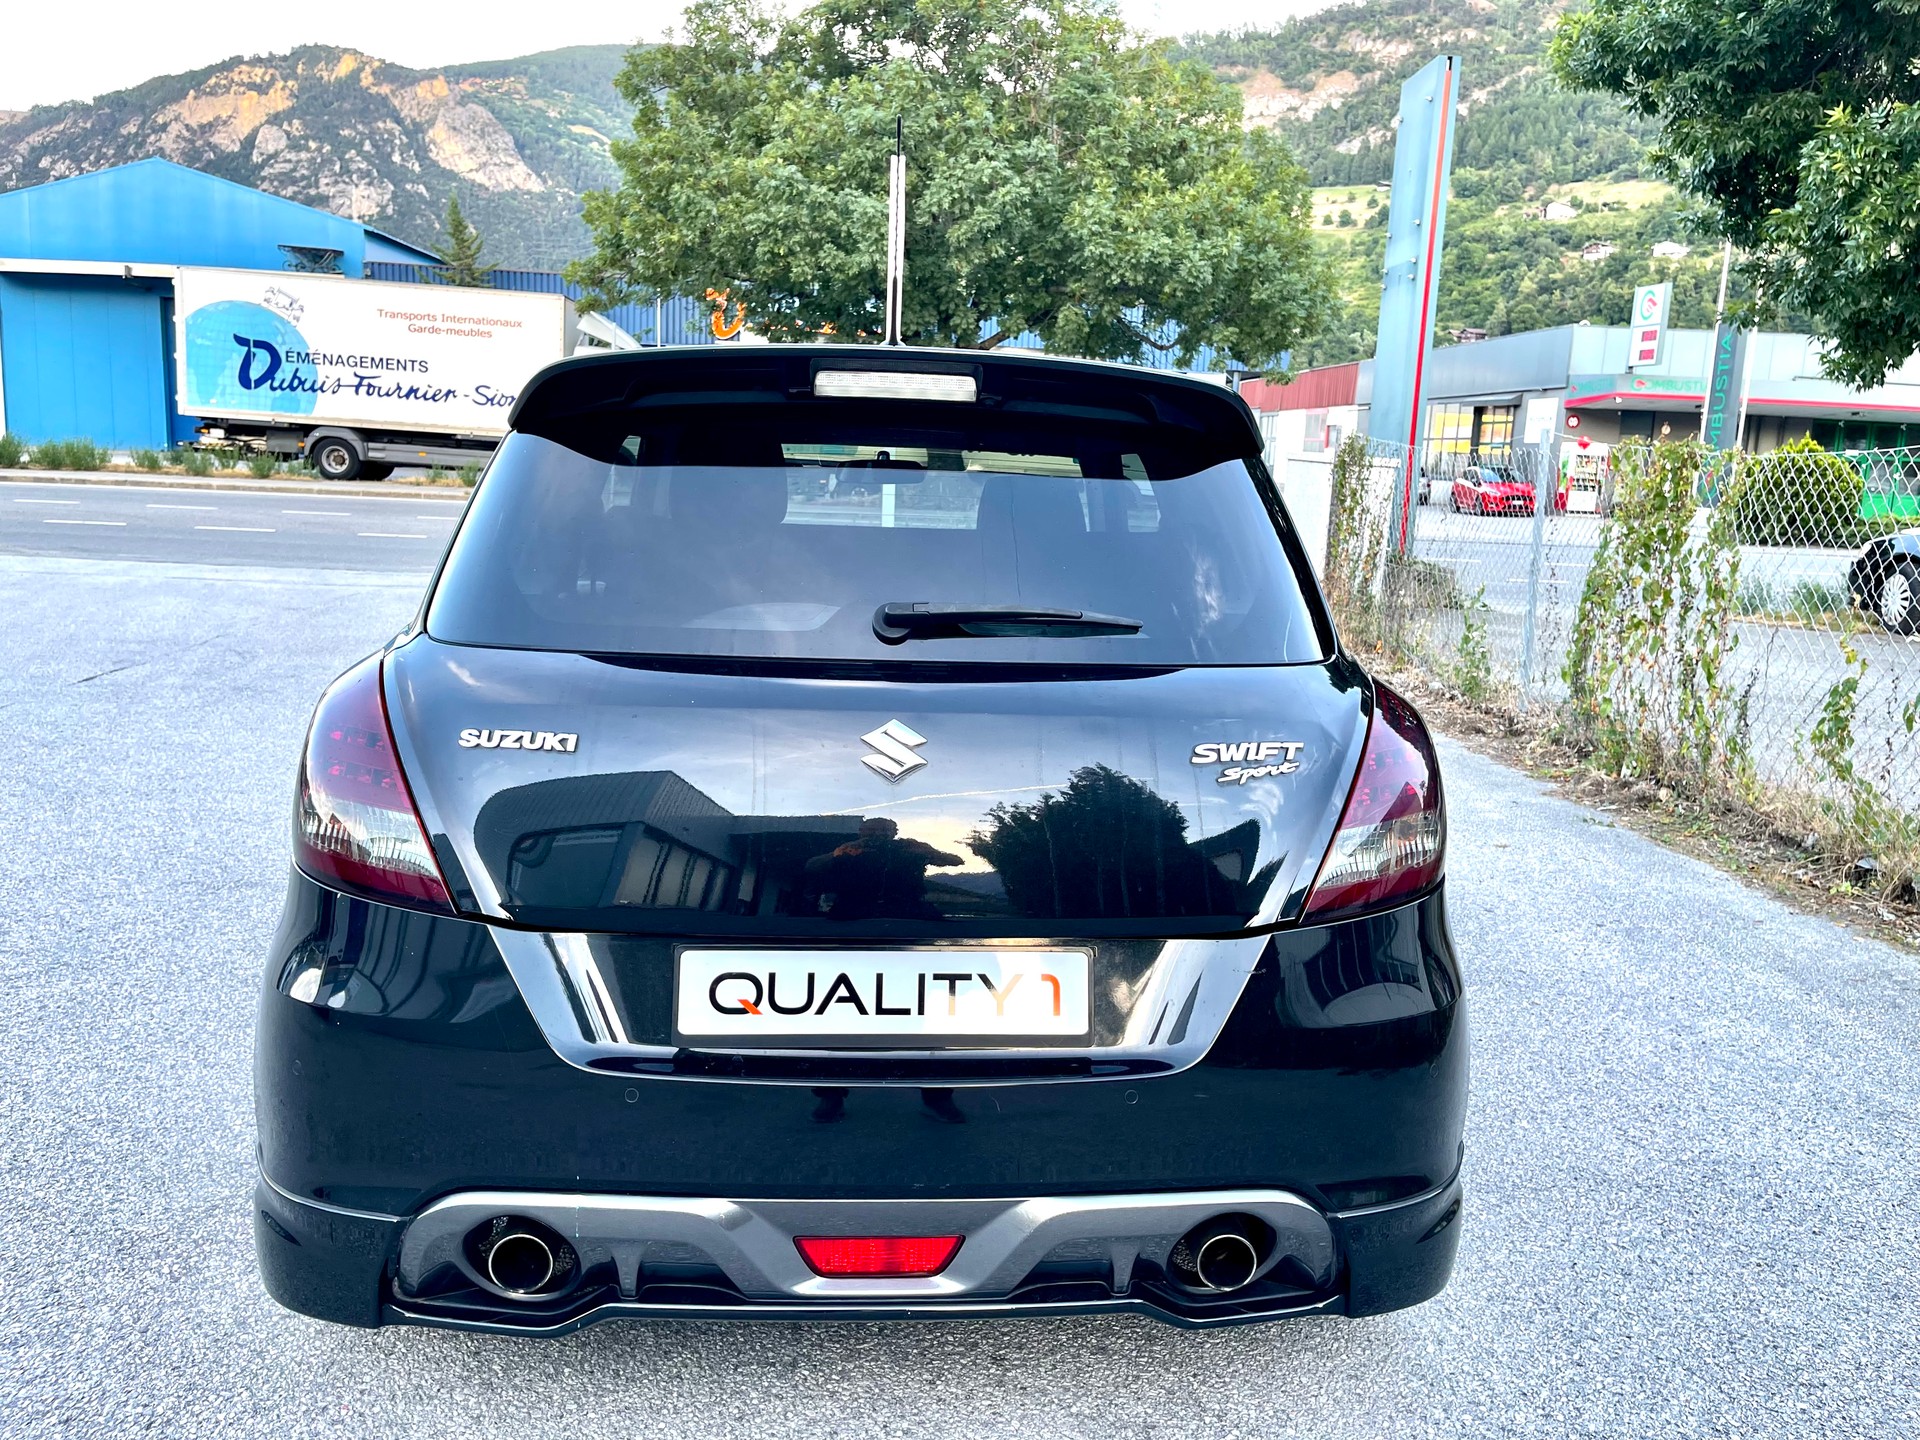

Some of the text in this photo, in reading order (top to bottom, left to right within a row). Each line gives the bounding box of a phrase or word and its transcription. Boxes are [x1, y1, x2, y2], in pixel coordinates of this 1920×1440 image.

[376, 308, 523, 328] Transports Internationaux
[408, 323, 493, 338] Garde-meubles
[458, 728, 578, 752] SUZUKI
[1191, 742, 1304, 764] SWIFT
[1217, 762, 1300, 785] Sport
[708, 972, 1024, 1016] QUALITY
